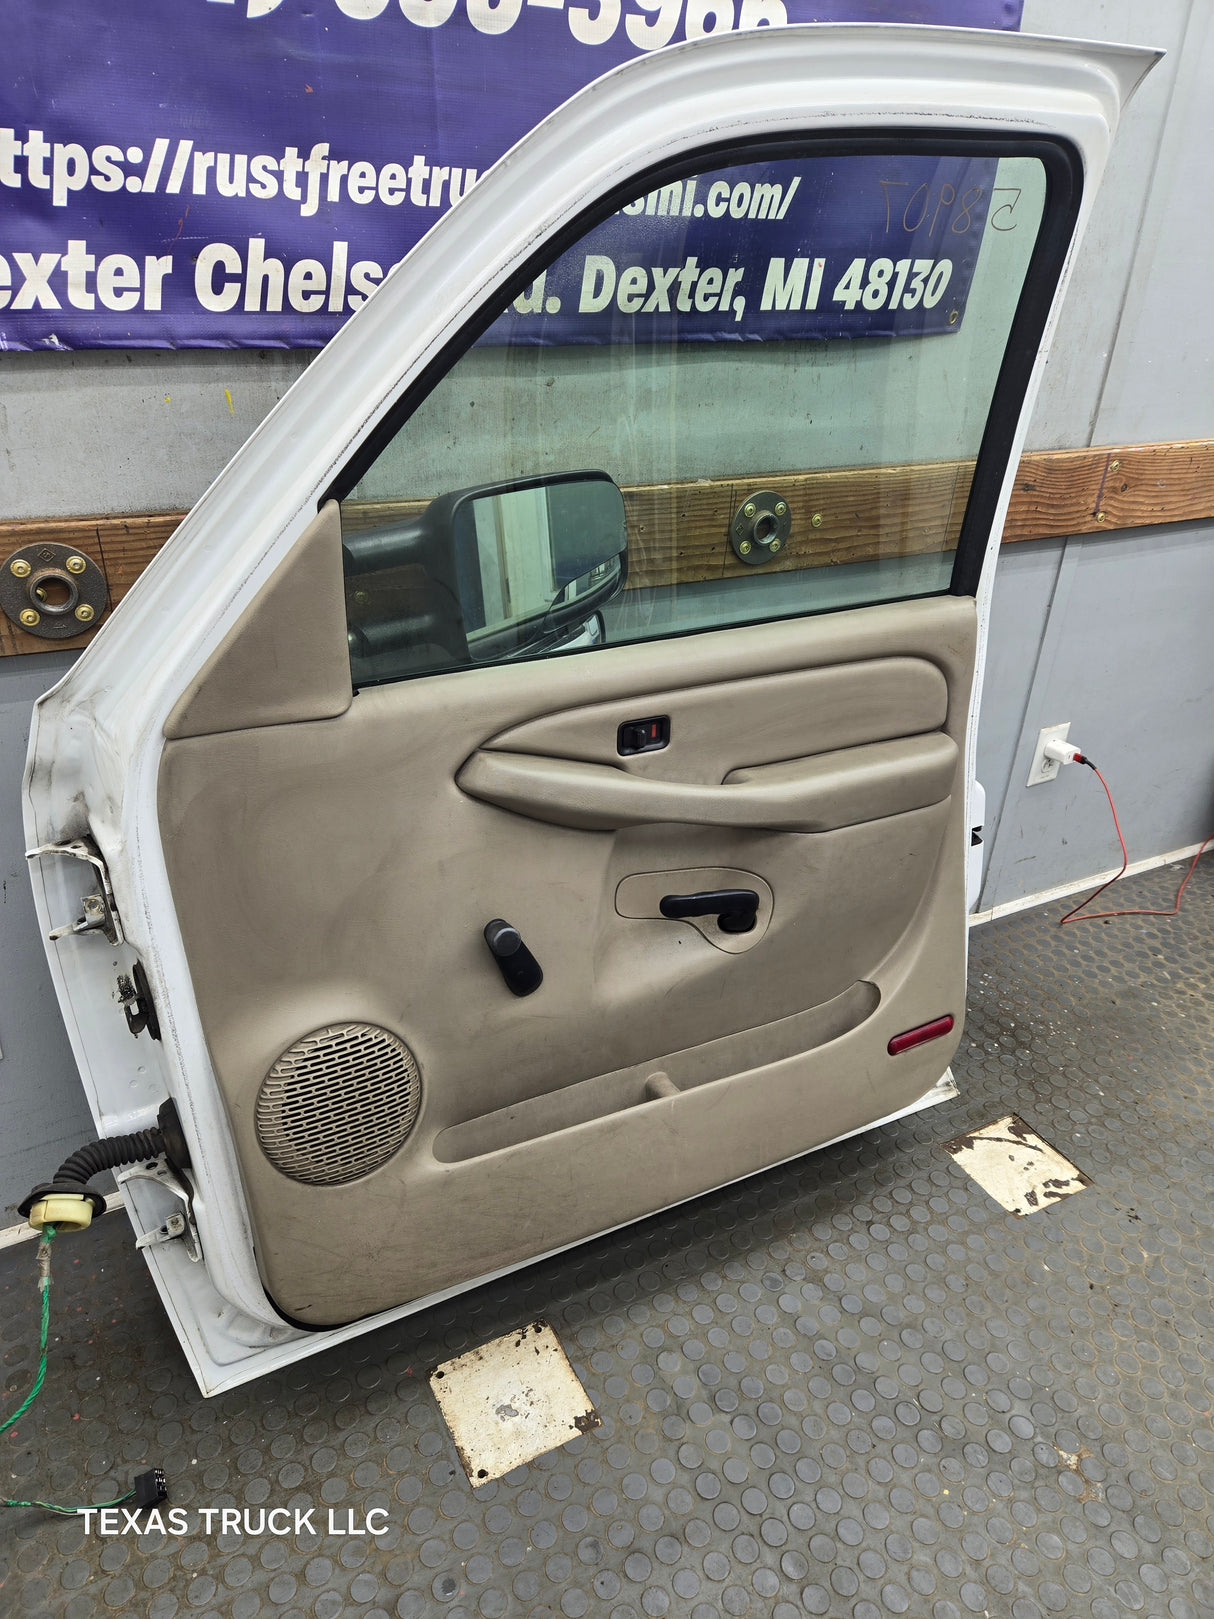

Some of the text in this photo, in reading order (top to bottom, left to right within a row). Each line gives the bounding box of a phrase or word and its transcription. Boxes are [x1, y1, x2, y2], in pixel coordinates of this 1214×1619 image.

[0, 127, 490, 216] ttps://rustfreetru
[194, 238, 400, 312] Chels
[578, 254, 746, 322] Dexter,
[760, 257, 826, 311] MI
[832, 257, 953, 311] 48130
